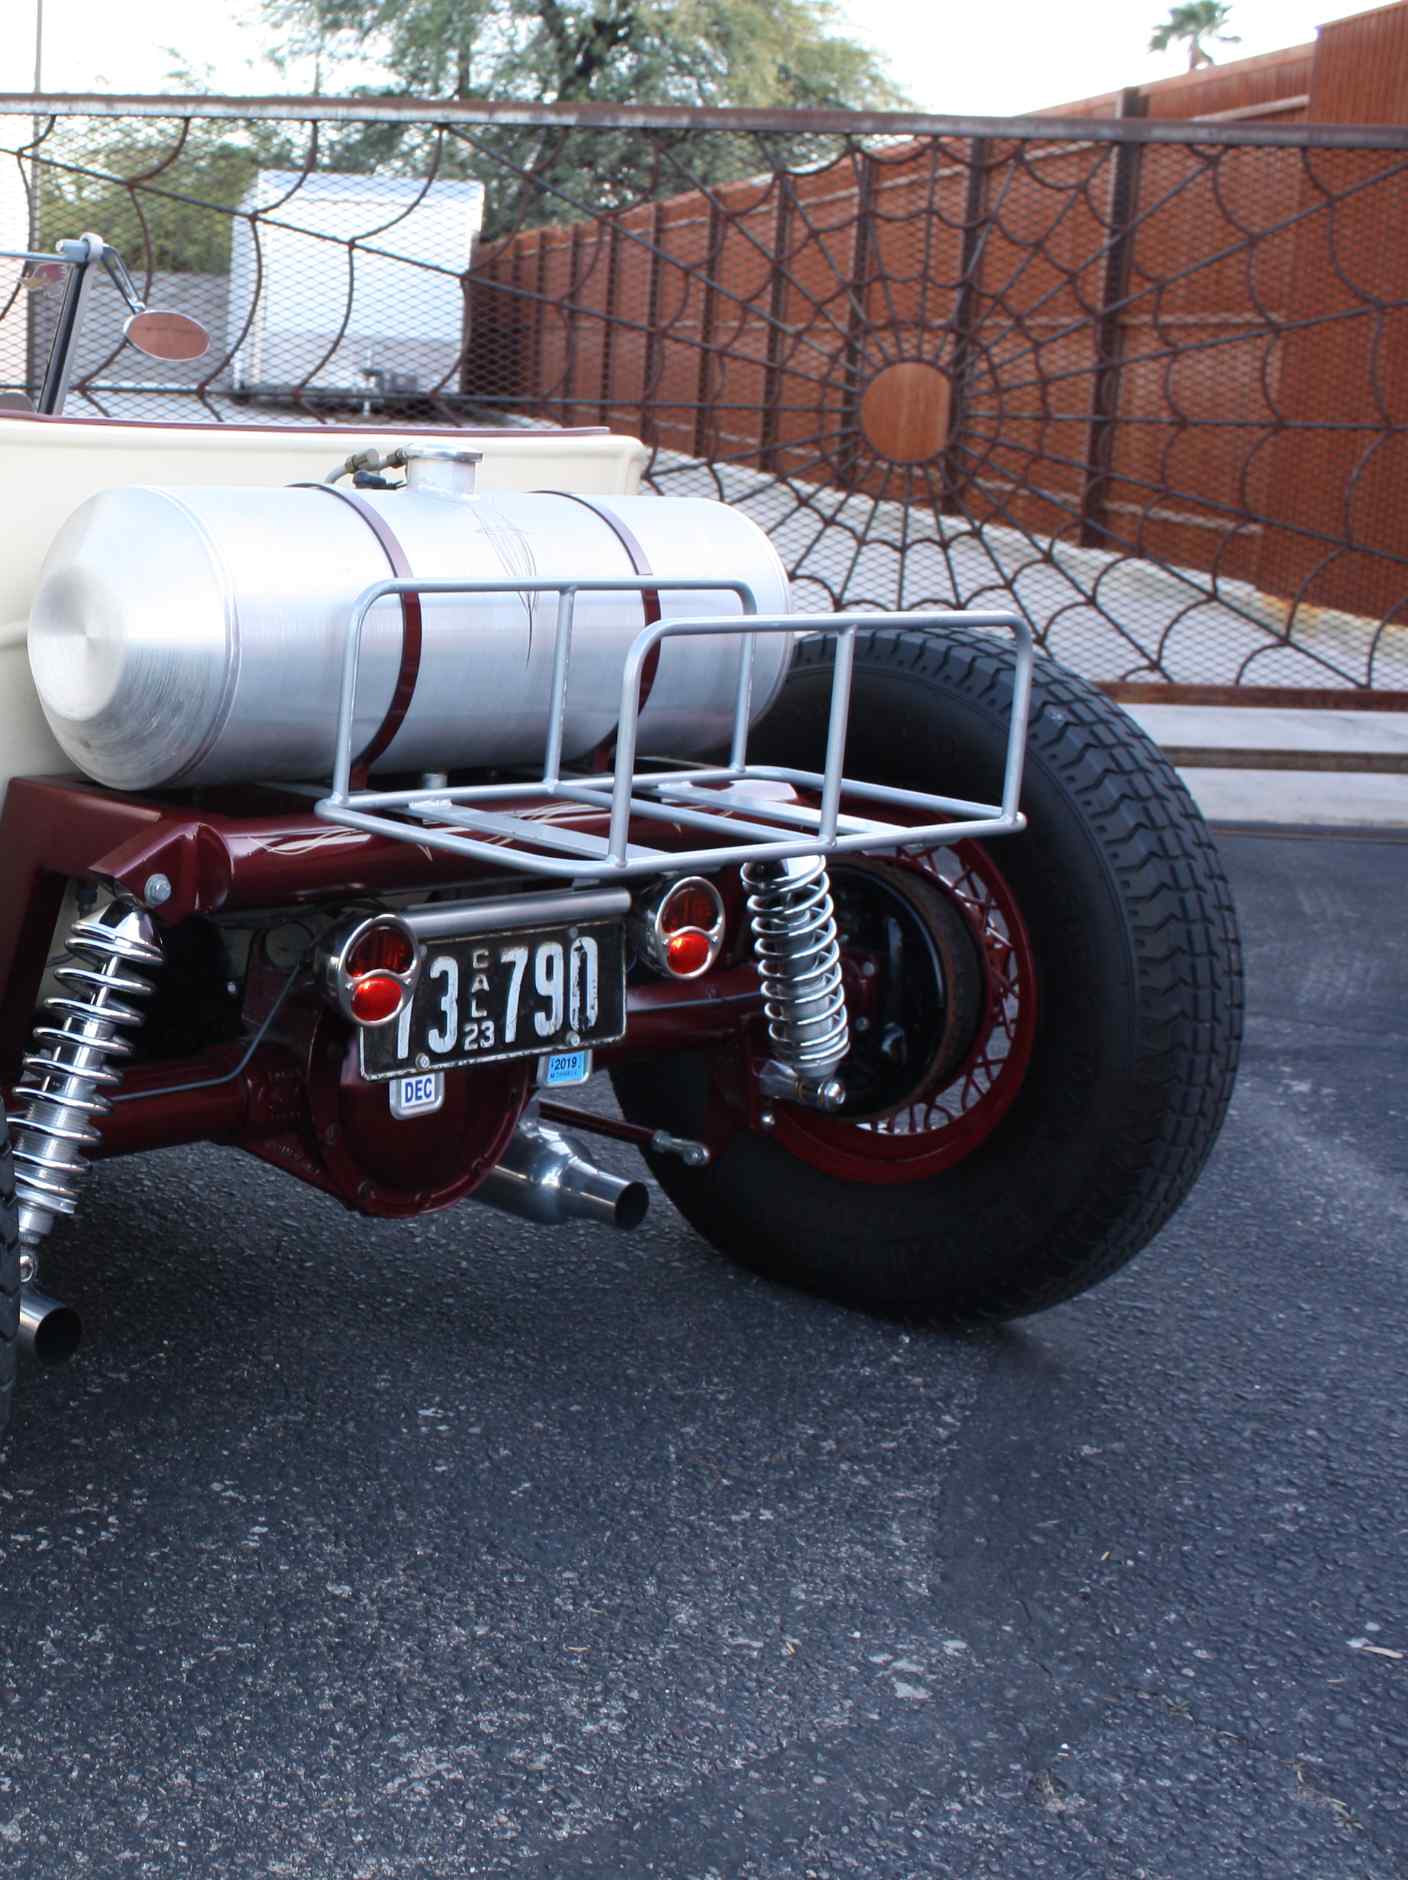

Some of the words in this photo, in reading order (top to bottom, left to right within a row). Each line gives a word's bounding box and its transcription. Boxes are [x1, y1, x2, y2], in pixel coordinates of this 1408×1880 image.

[472, 949, 490, 1018] CAL
[500, 936, 598, 1044] 790
[464, 1020, 495, 1050] 23
[554, 1056, 577, 1071] 2019
[404, 1078, 433, 1103] DEC
